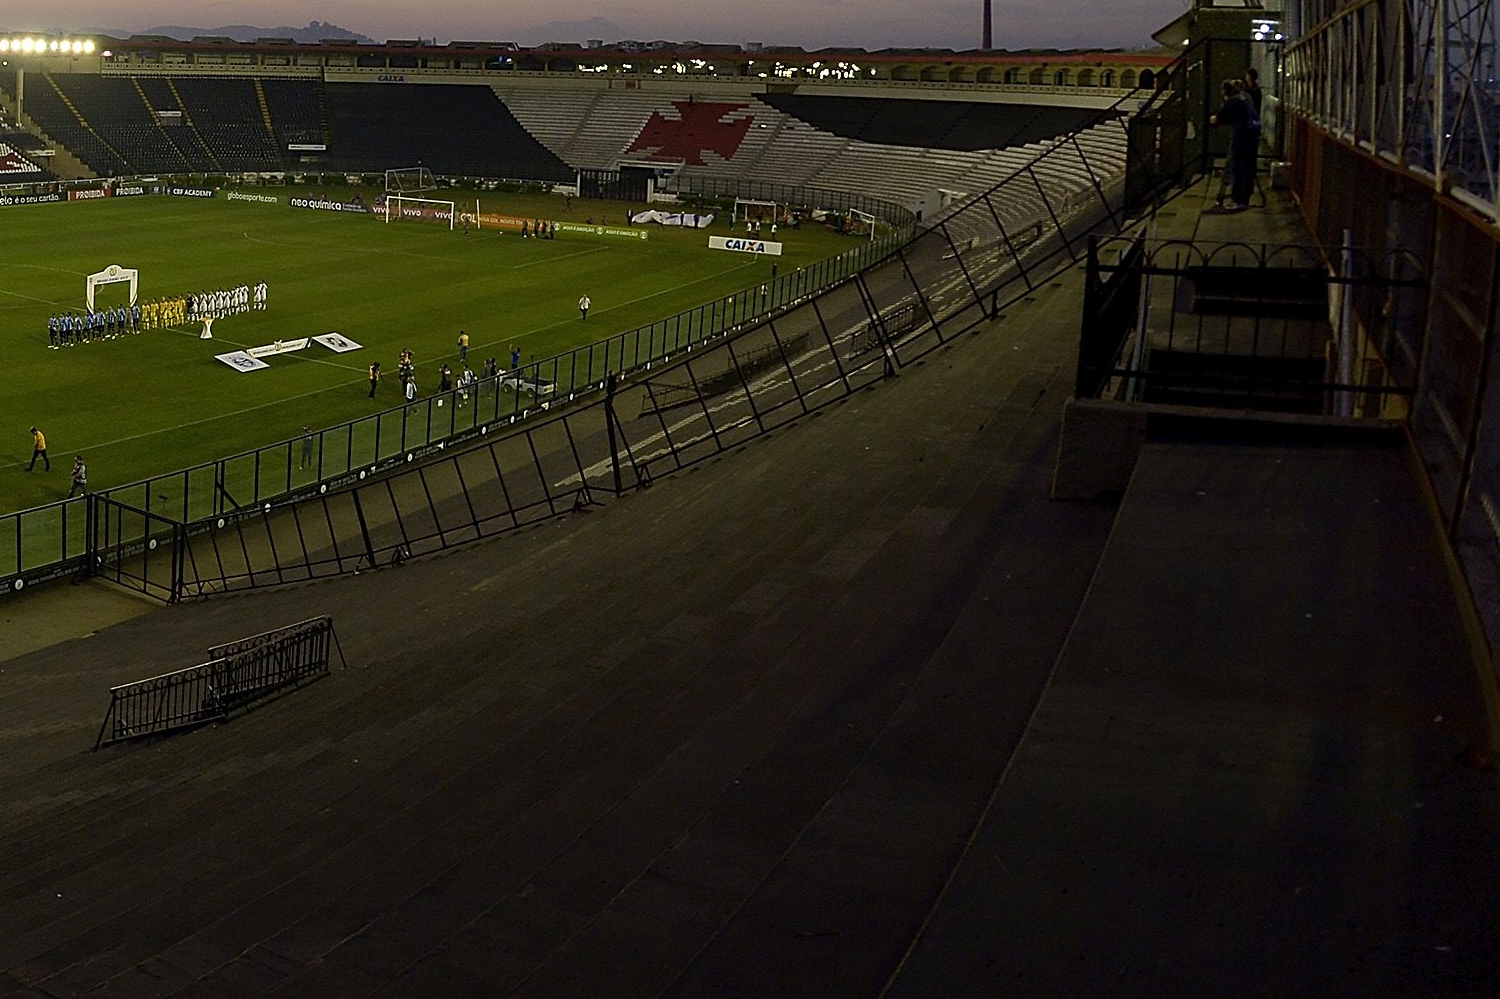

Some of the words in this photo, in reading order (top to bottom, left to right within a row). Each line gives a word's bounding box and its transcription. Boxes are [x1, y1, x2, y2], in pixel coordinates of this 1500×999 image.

[76, 190, 105, 200] PROIBIDA
[116, 187, 144, 196] PROIBIDA
[184, 189, 213, 198] ACADEMY
[0, 196, 12, 206] elo
[27, 196, 38, 204] seu
[227, 192, 278, 203] globoesporte.com
[291, 198, 308, 208] neo
[309, 199, 342, 212] química
[403, 209, 421, 217] VIVO
[725, 239, 765, 253] CAIXA
